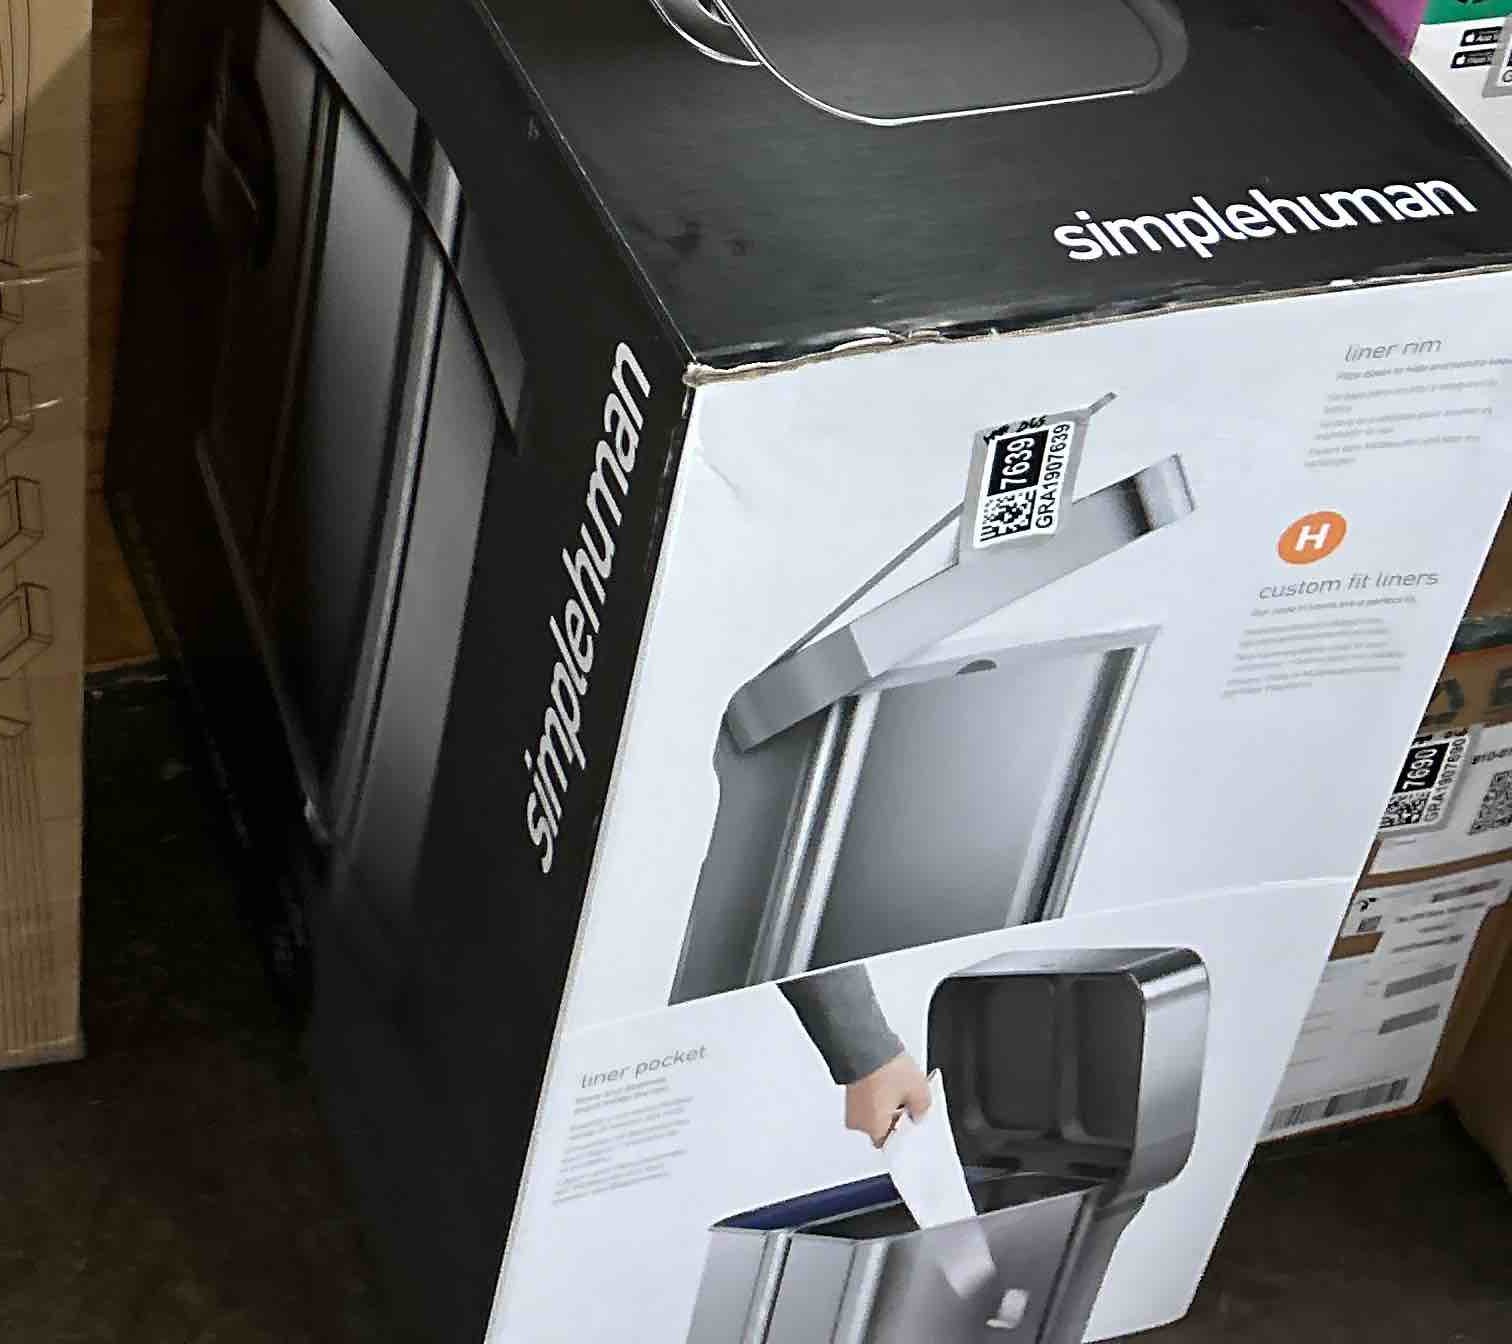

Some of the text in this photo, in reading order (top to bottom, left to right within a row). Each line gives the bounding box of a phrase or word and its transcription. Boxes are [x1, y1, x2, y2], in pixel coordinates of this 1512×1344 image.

[1053, 177, 1480, 261] simplehuman
[1345, 338, 1443, 363] liner rim
[999, 437, 1035, 491] 7639
[1035, 423, 1071, 529] GRA1907639
[1295, 522, 1332, 552] H
[524, 341, 651, 874] simplehuman
[1257, 570, 1440, 600] custom fit liners
[1402, 747, 1438, 792] 7690
[581, 1044, 708, 1089] liner pocket
